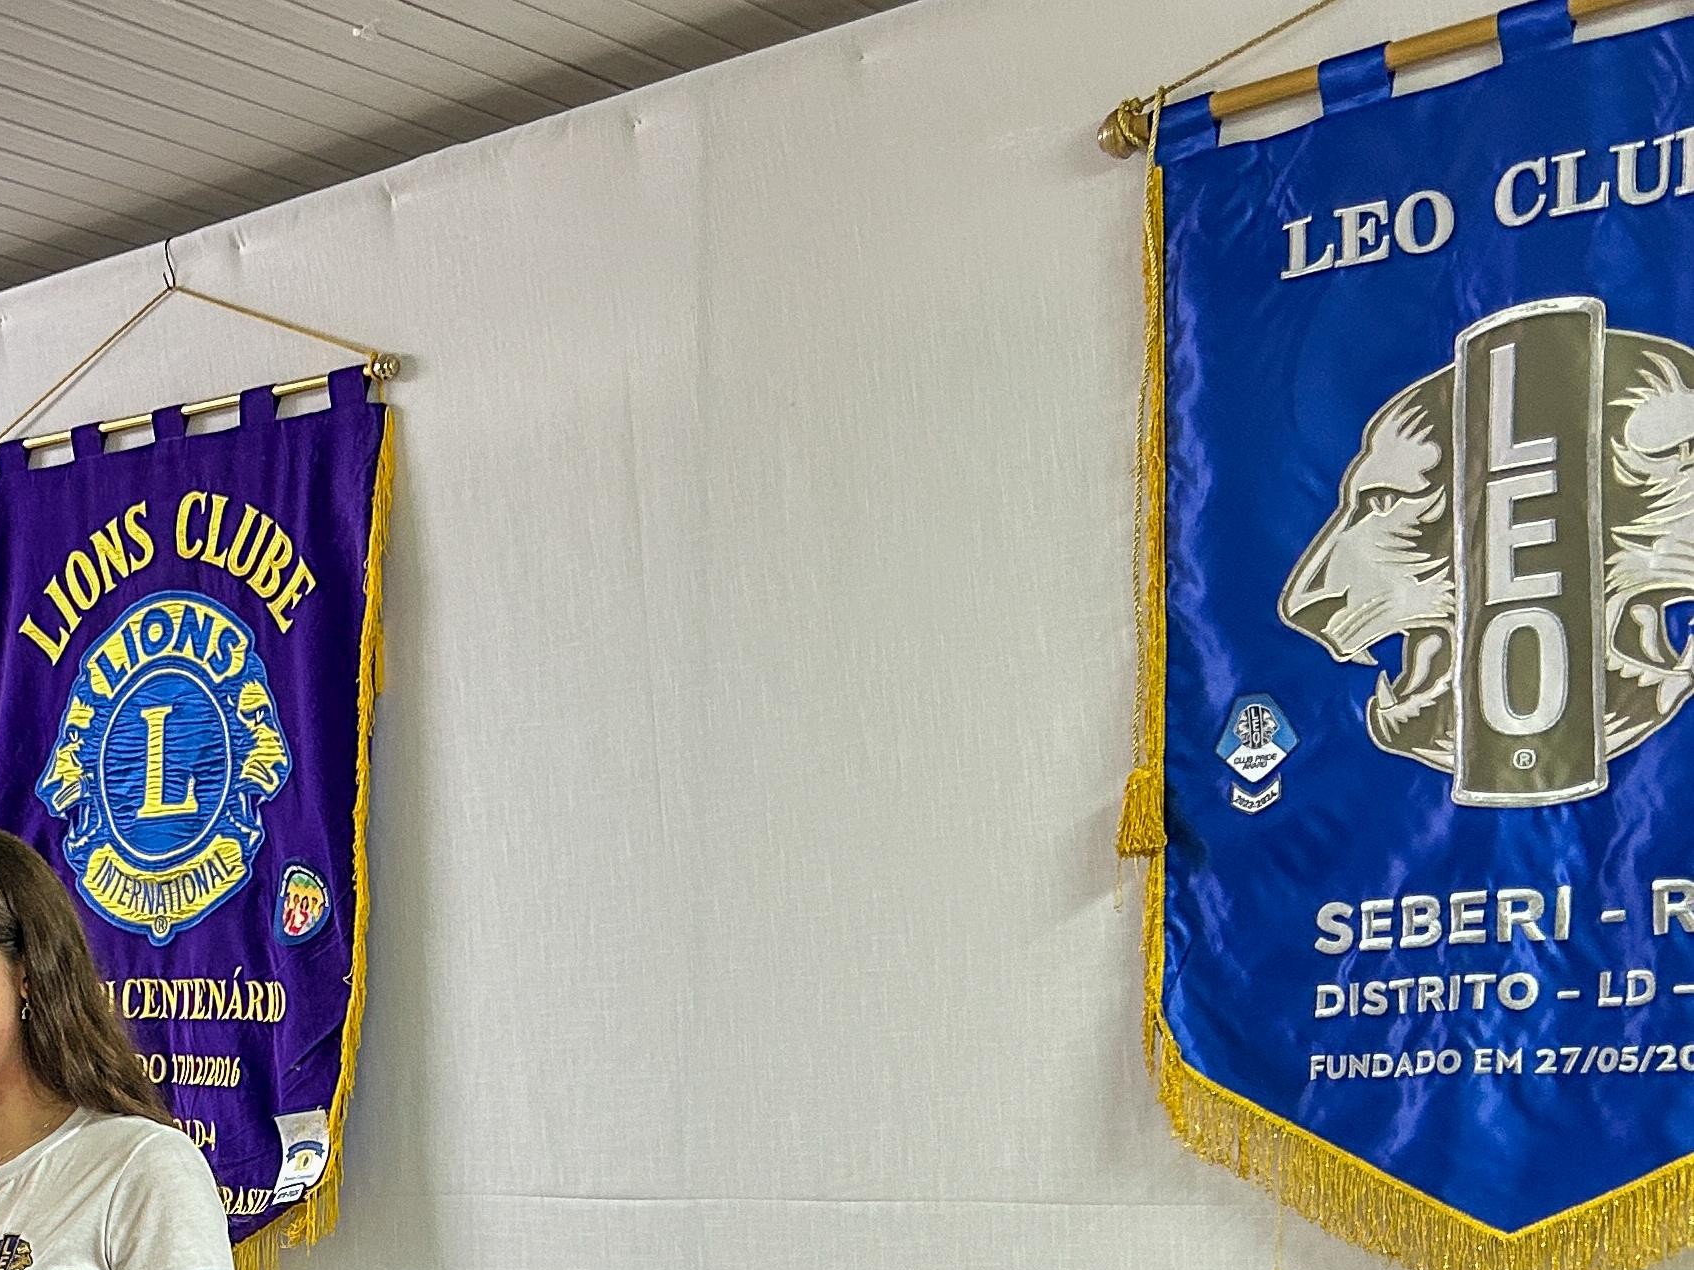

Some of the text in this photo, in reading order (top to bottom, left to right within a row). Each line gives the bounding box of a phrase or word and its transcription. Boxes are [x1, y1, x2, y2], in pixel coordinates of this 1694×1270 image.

[1280, 189, 1455, 280] LEO
[1478, 342, 1569, 736] LEO
[18, 490, 316, 666] LIONS CLUBE
[94, 604, 241, 689] LIONS
[1251, 708, 1261, 745] LEO
[135, 705, 197, 819] L
[92, 850, 237, 915] INTERNATIONAL
[1314, 884, 1572, 955] SEBERI
[121, 965, 287, 1023] CENTENÁRIO
[1314, 971, 1540, 1018] DISTRITO
[1597, 969, 1656, 1008] LD
[170, 1053, 241, 1088] 17/12/2016
[1310, 1048, 1462, 1081] FUNDADO
[1473, 1047, 1523, 1075] EM
[218, 1186, 274, 1215] RASIL
